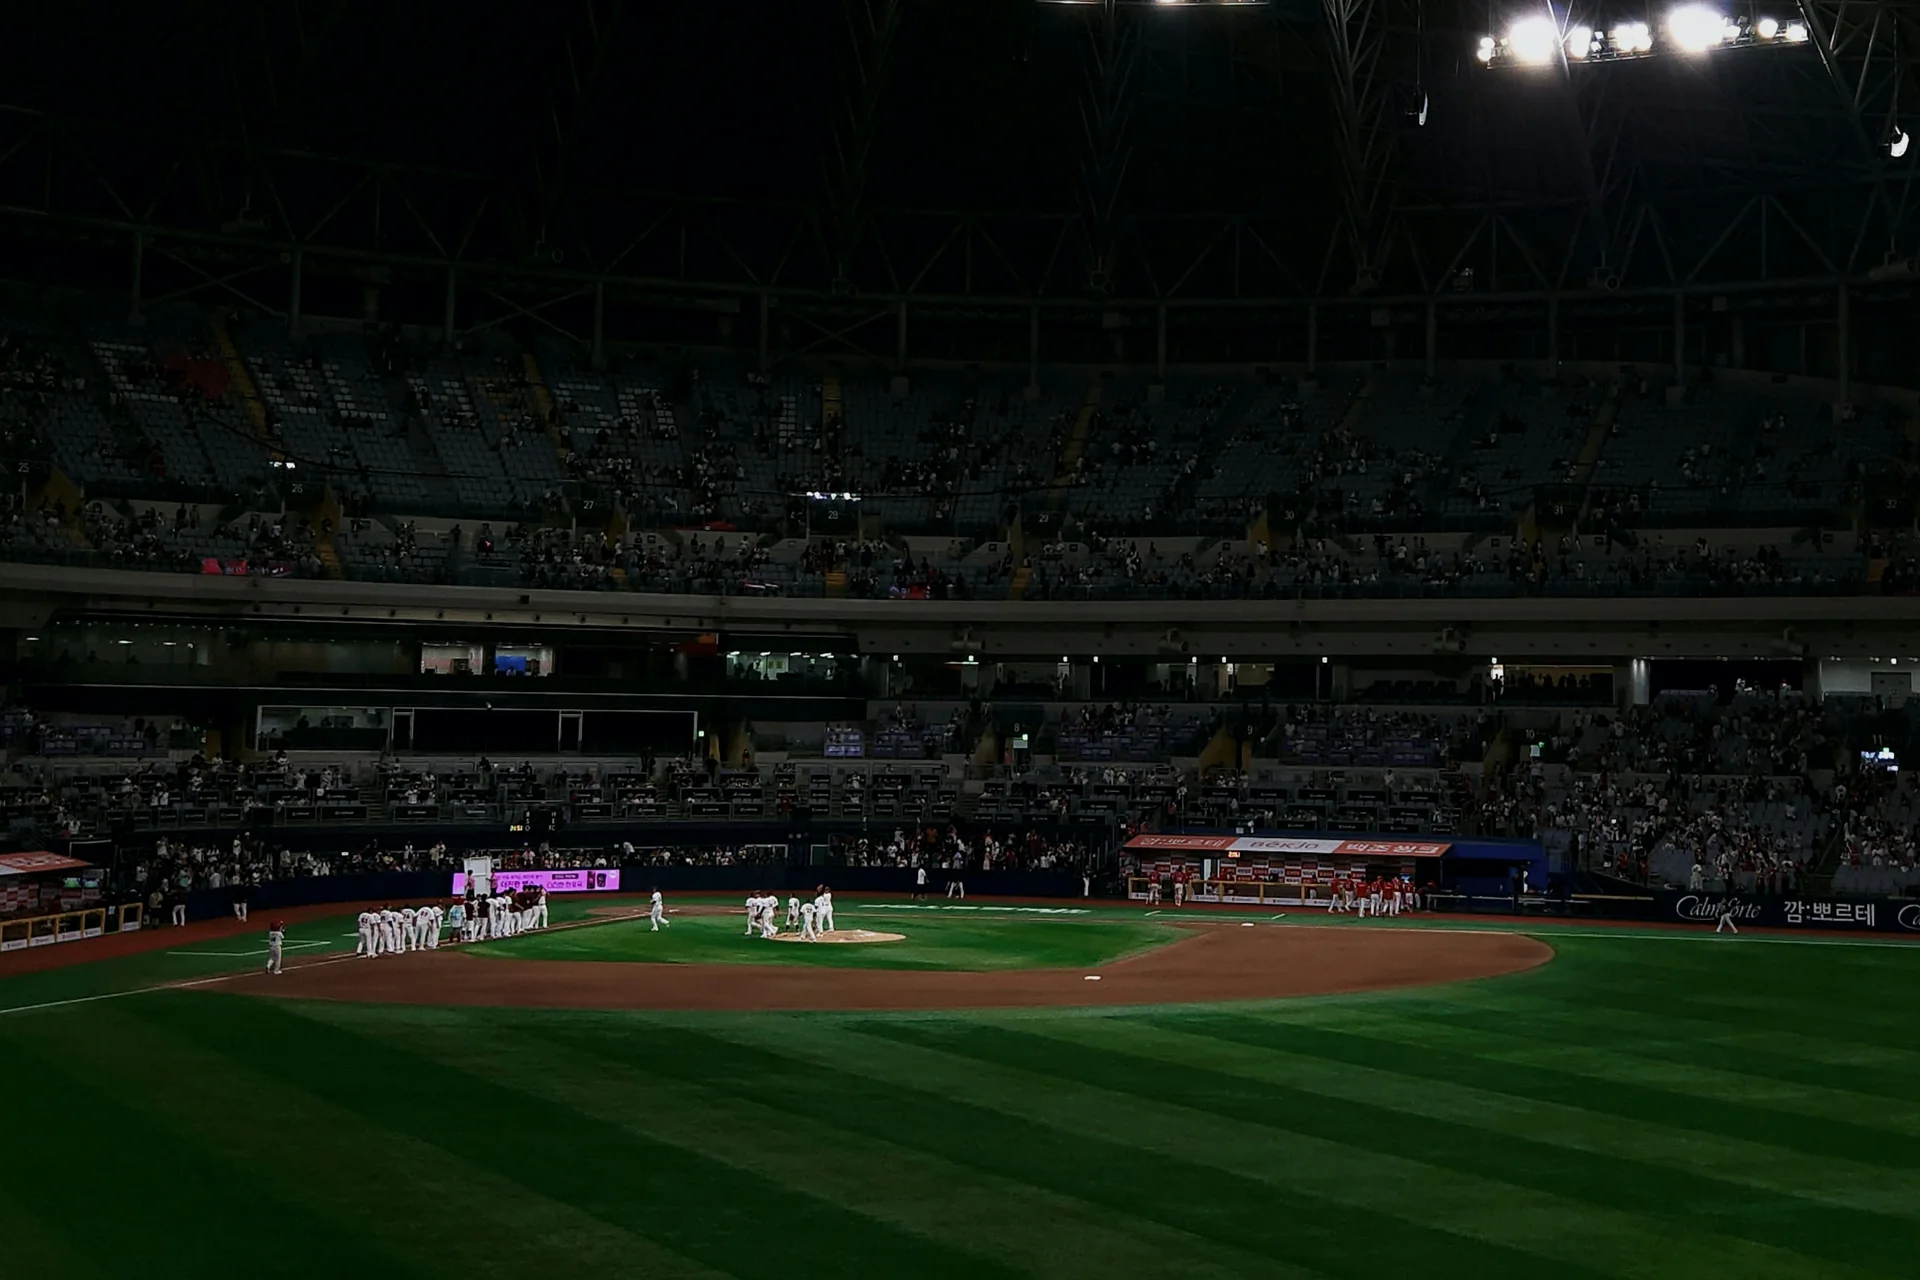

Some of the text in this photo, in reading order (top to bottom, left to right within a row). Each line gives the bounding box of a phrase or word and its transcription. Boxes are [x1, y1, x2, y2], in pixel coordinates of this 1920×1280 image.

[17, 462, 30, 473] 25
[291, 483, 303, 494] 26
[583, 500, 594, 510] 27
[1013, 722, 1020, 732] 8
[1247, 724, 1253, 735] 9
[1525, 729, 1535, 740] 10
[1872, 734, 1883, 746] 11
